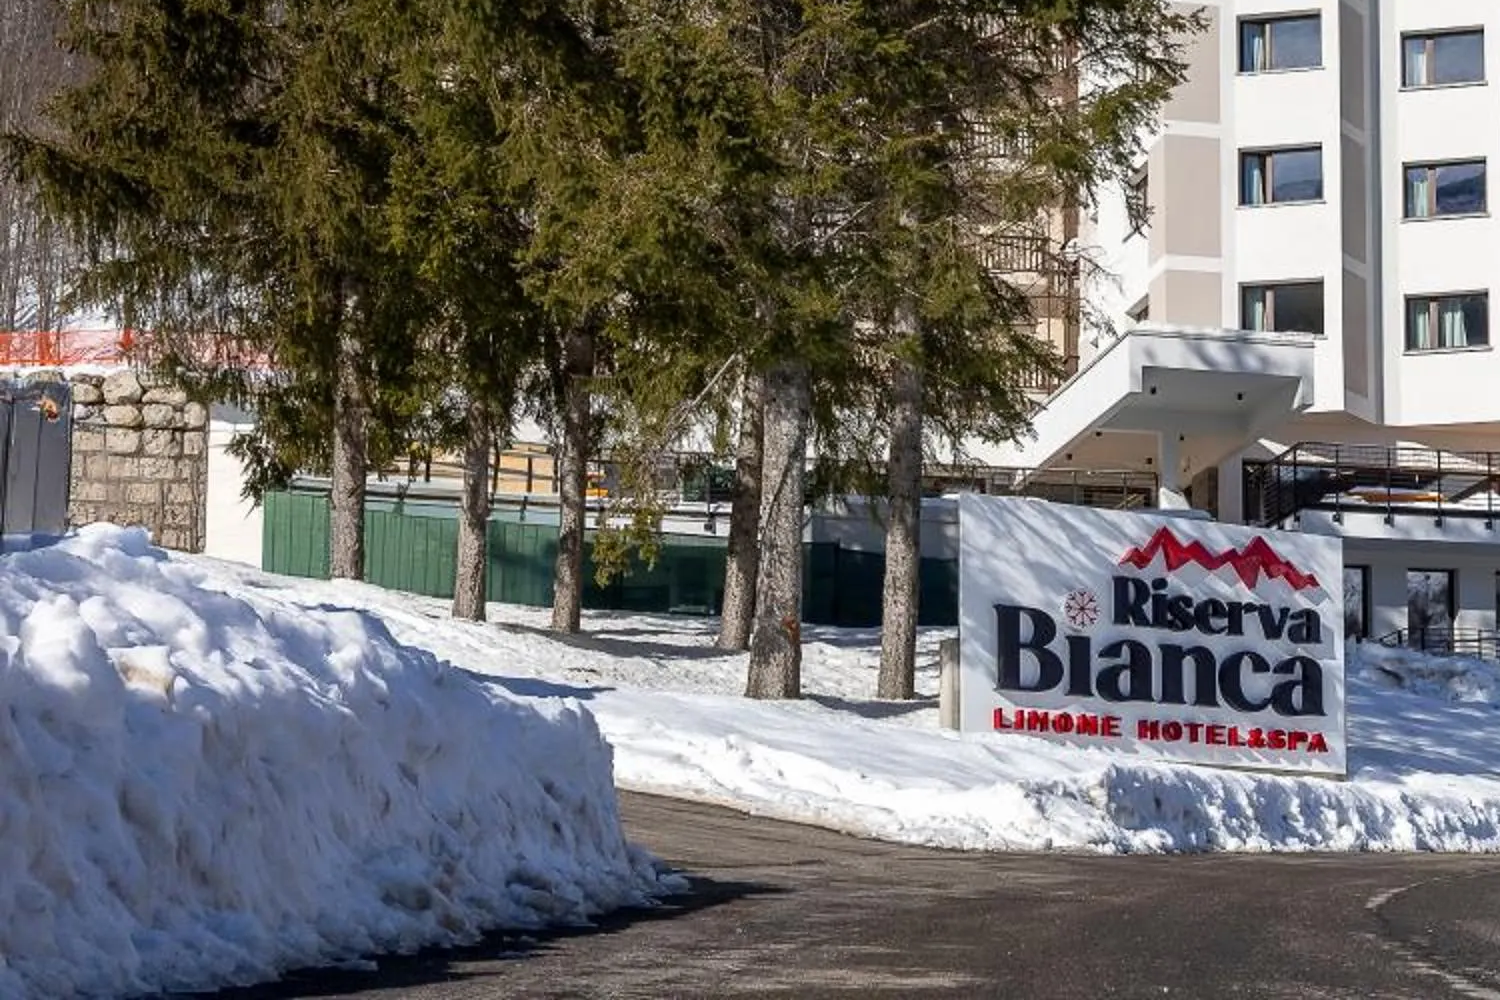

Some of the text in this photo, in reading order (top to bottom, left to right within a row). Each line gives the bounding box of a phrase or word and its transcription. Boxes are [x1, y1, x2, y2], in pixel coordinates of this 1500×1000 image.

[1112, 575, 1322, 644] Riserva
[993, 591, 1327, 717] Bianca
[993, 708, 1123, 737] LIMONE
